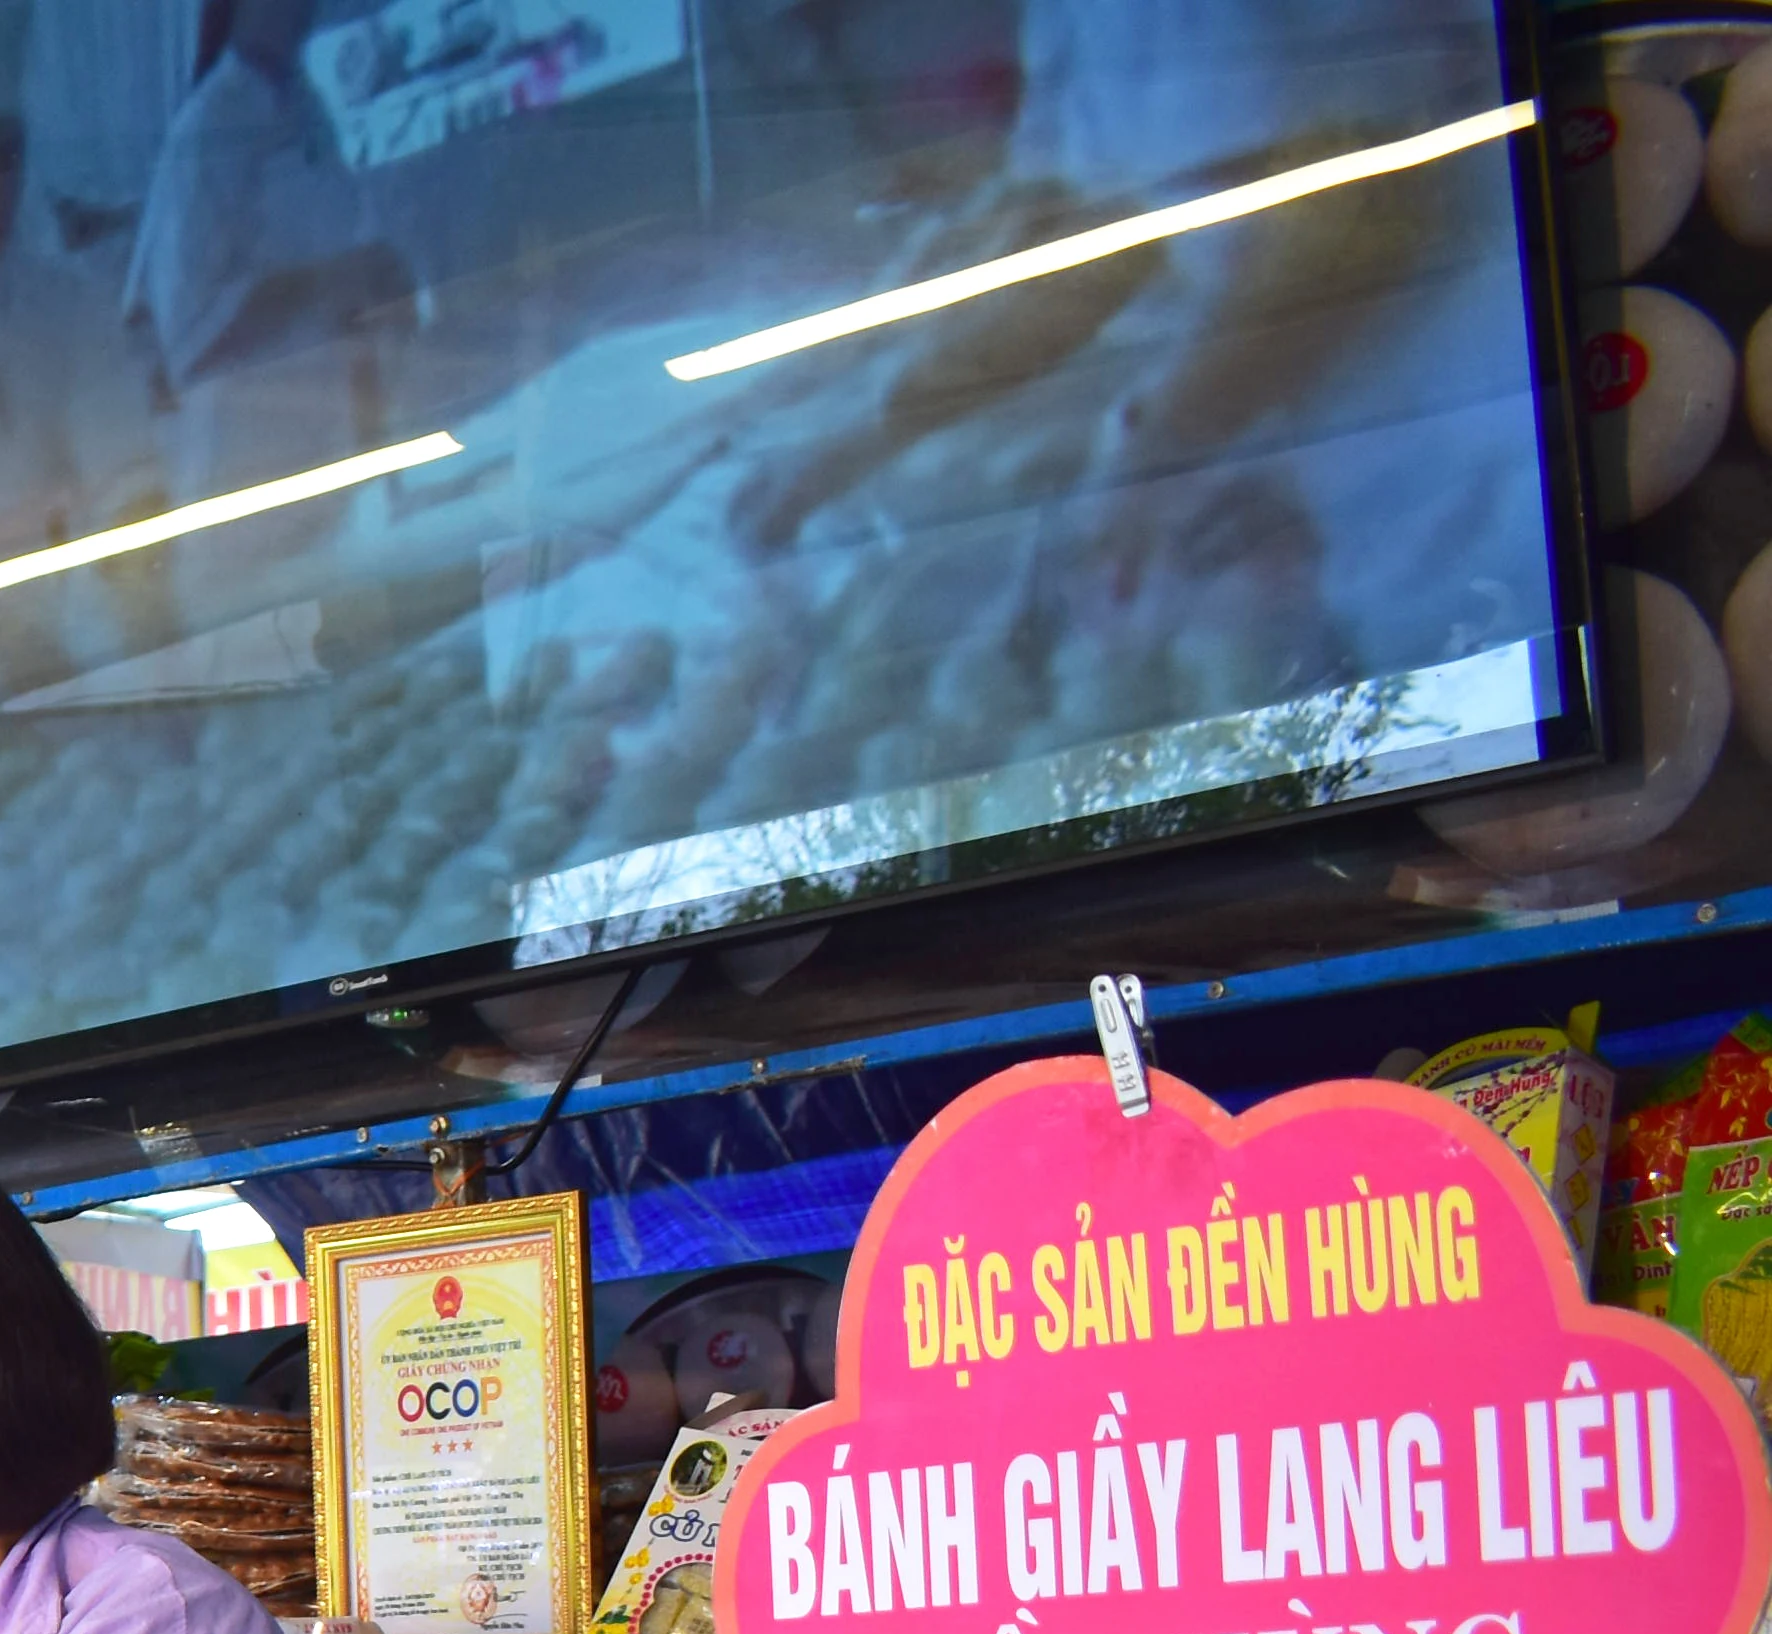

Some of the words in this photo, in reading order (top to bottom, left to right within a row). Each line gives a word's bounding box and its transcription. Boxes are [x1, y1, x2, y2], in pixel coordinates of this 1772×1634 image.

[904, 1235, 1014, 1388] ĐẶC
[1033, 1202, 1149, 1353] SẢN
[1168, 1182, 1289, 1336] ĐỀN
[1304, 1175, 1481, 1318] HÙNG
[397, 1375, 503, 1422] OCOP
[766, 1445, 979, 1622] BÁNH
[1003, 1393, 1188, 1603] GIẦY
[1215, 1412, 1447, 1584] LANG
[1473, 1361, 1677, 1563] LIÊU
